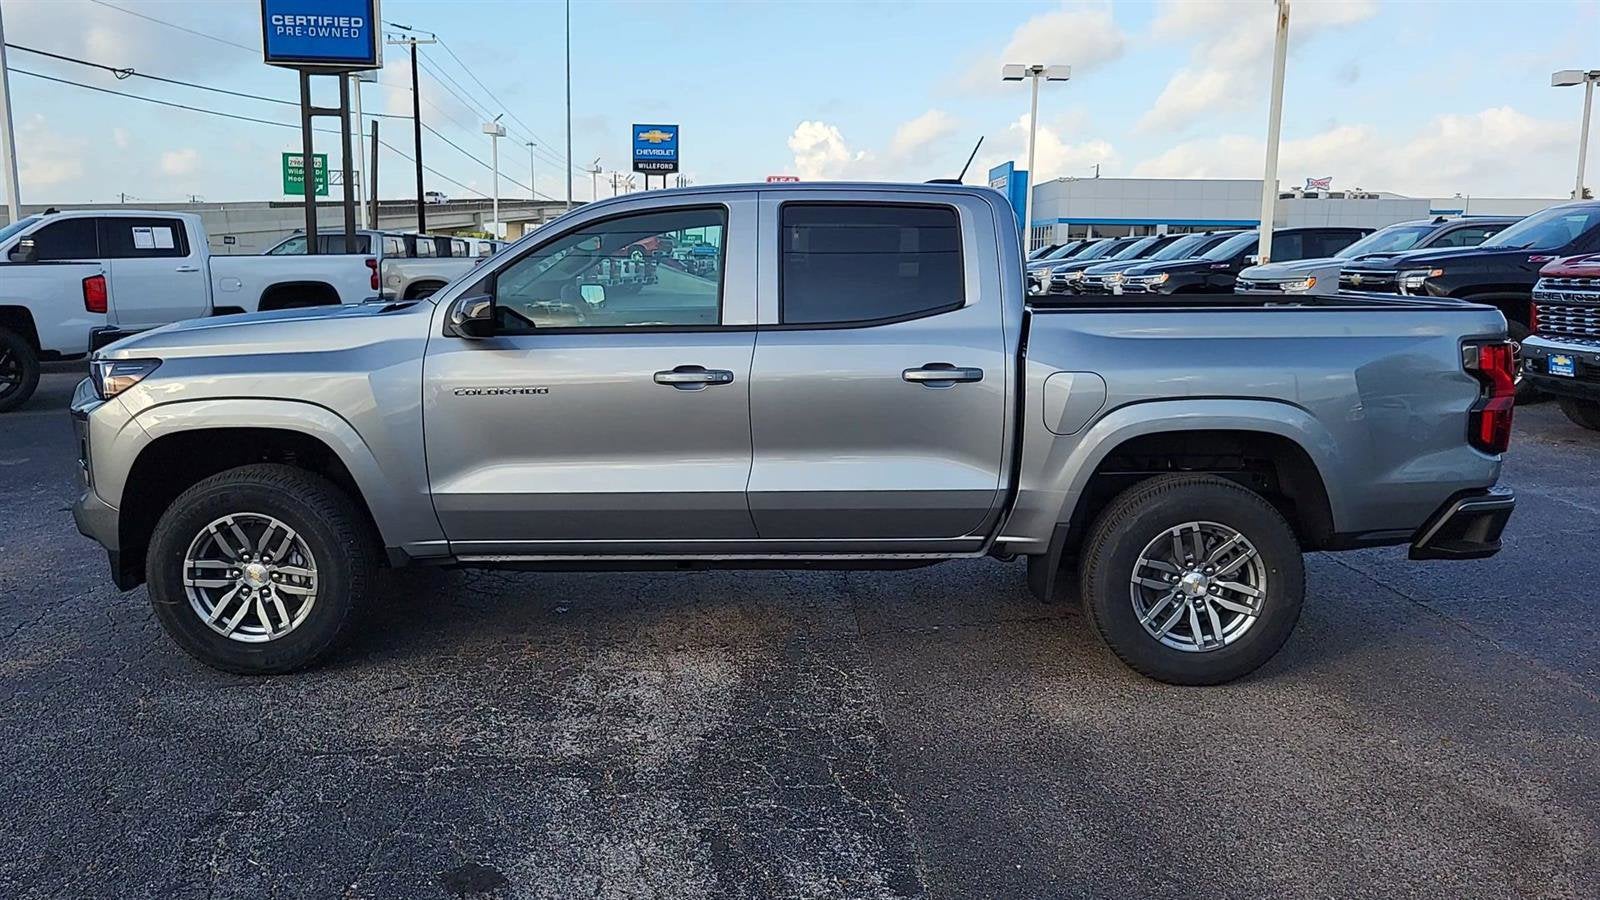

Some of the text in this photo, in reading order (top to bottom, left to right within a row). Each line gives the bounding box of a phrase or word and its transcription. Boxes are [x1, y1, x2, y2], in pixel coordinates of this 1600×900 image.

[272, 15, 363, 27] CERTIFIED
[277, 26, 359, 38] PRE-OWNED
[454, 386, 549, 396] COLORADO
